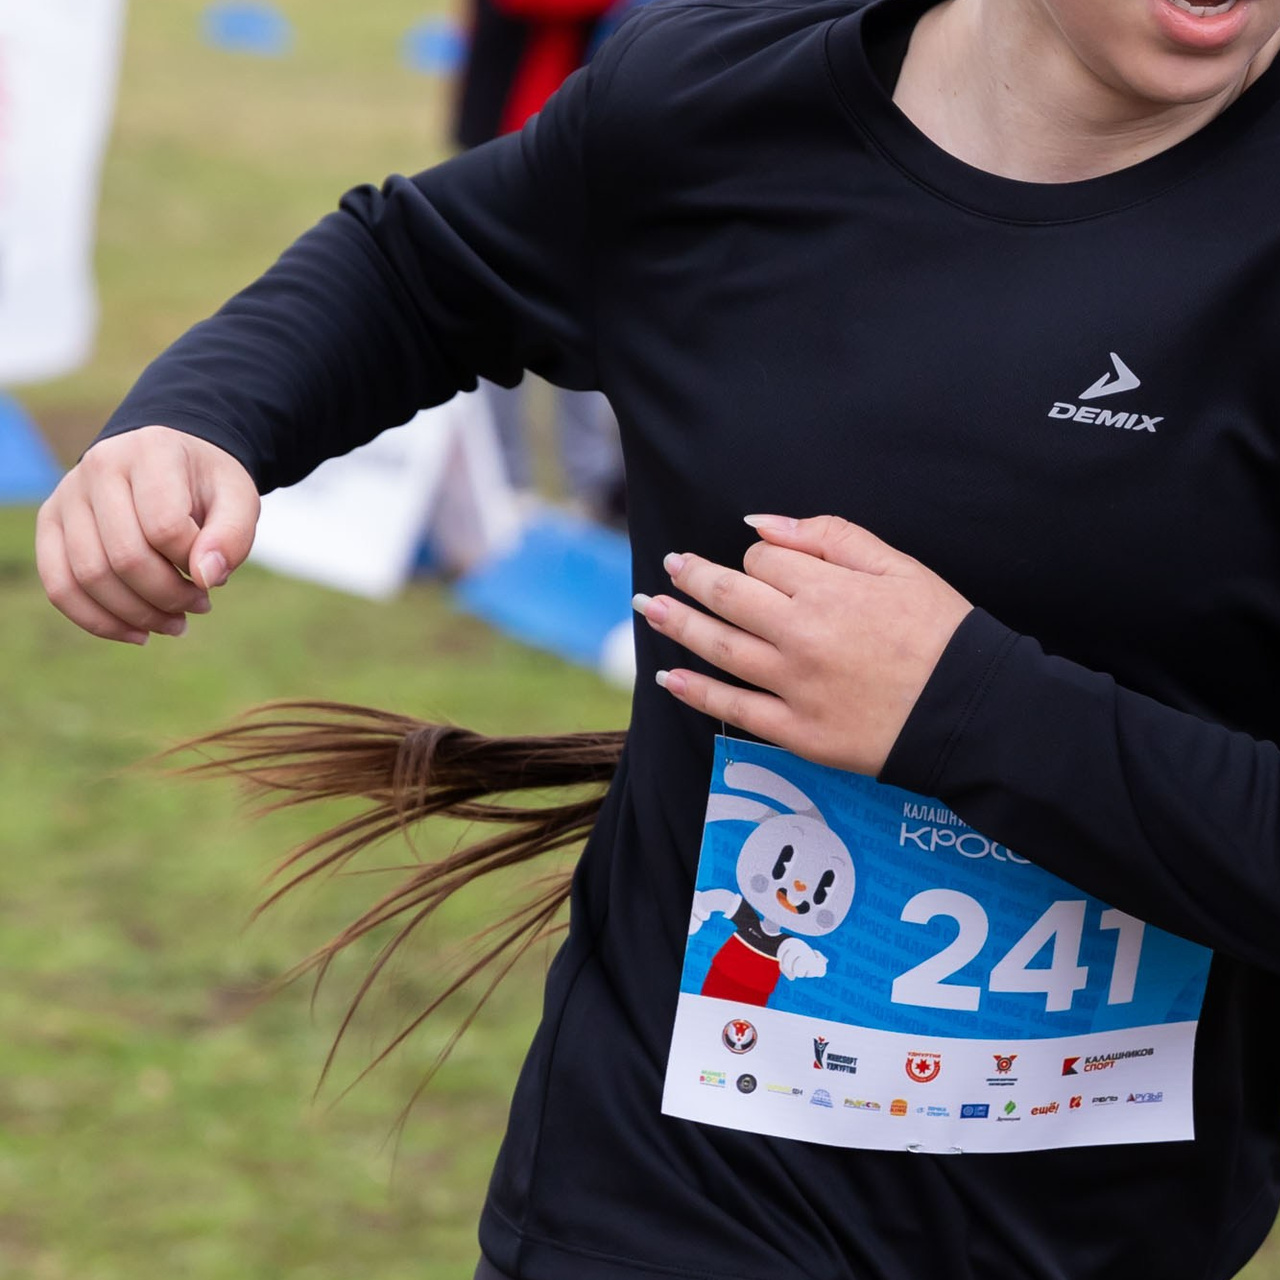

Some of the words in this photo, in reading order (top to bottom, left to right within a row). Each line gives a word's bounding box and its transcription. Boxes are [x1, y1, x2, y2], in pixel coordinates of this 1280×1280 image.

[1047, 402, 1164, 433] DEMIX
[903, 802, 971, 829] КАЛАШН
[891, 888, 1146, 1012] 241
[1083, 1061, 1116, 1072] СПОРТ
[1084, 1048, 1154, 1064] КАЛАШНИКОВ
[1030, 1102, 1060, 1116] ещё!
